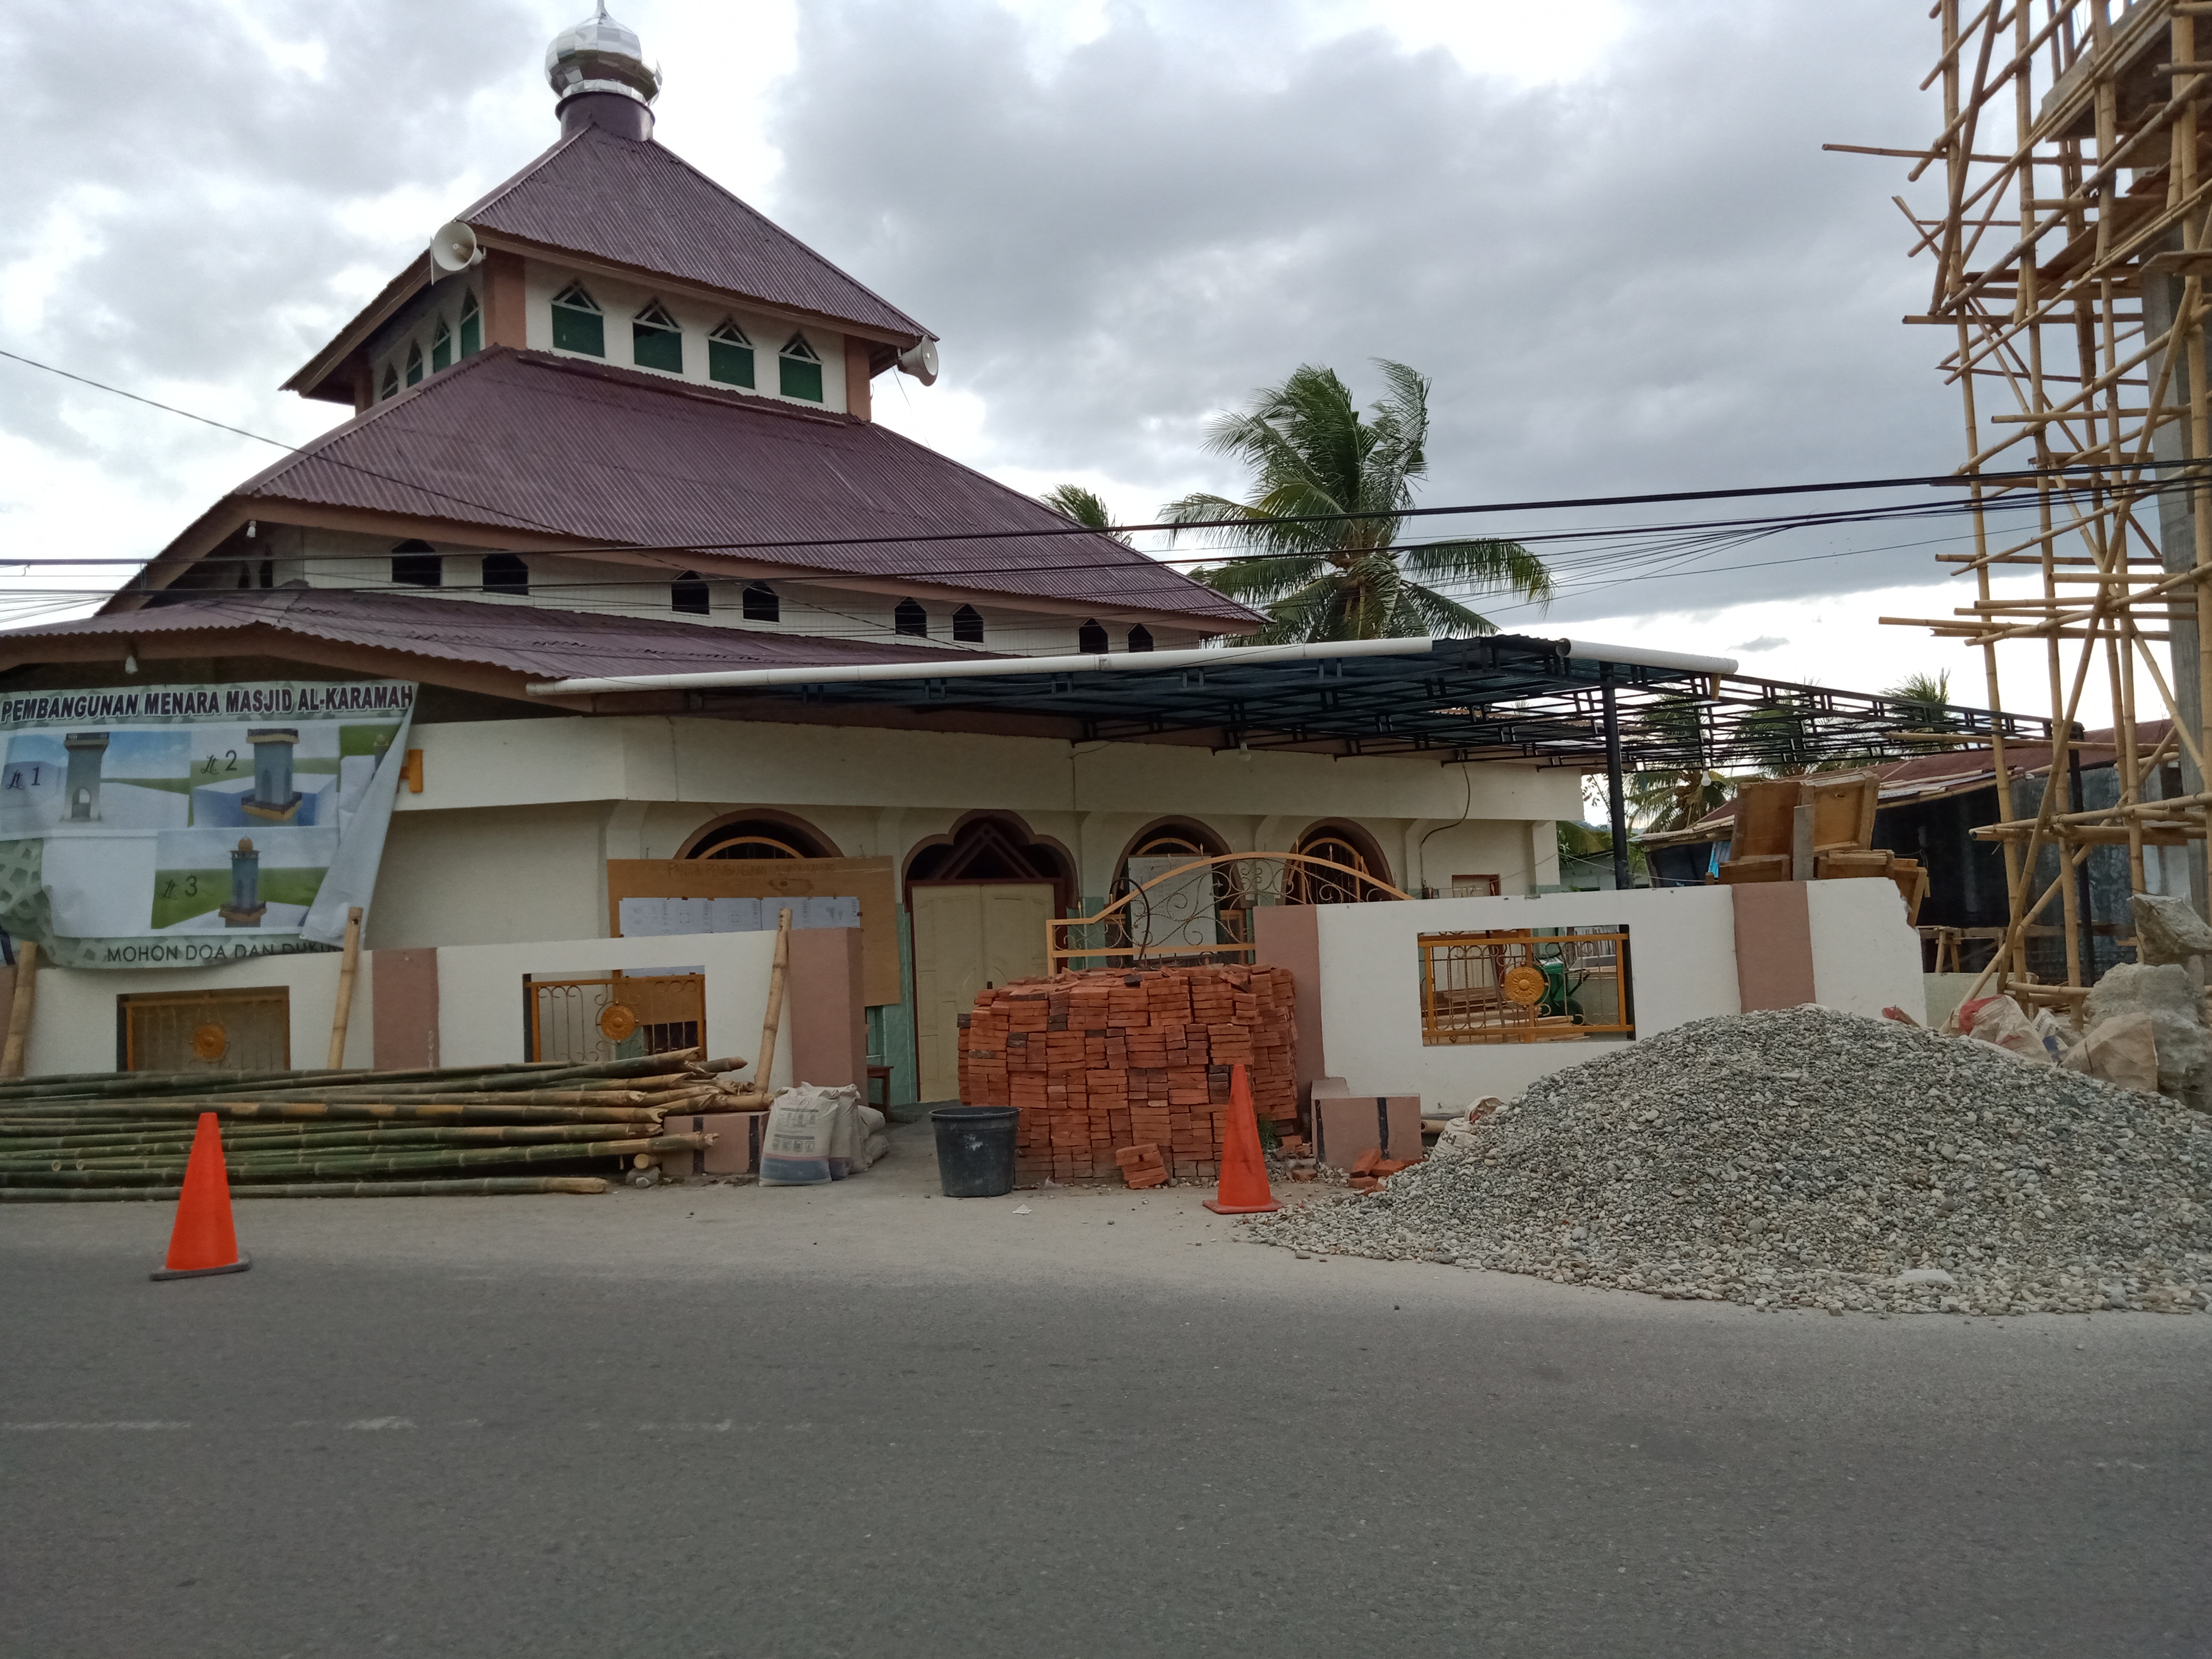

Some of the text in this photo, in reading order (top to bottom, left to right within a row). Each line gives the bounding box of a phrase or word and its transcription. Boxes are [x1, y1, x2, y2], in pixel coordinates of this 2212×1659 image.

[1, 685, 413, 723] PEMBANGUNAN MENARA MASJID AL-KARAMAH
[225, 750, 237, 771] 2
[31, 767, 40, 785] 1
[184, 875, 197, 897] 3
[107, 945, 178, 962] MOHON
[186, 944, 227, 960] DOA
[234, 943, 274, 957] DAN
